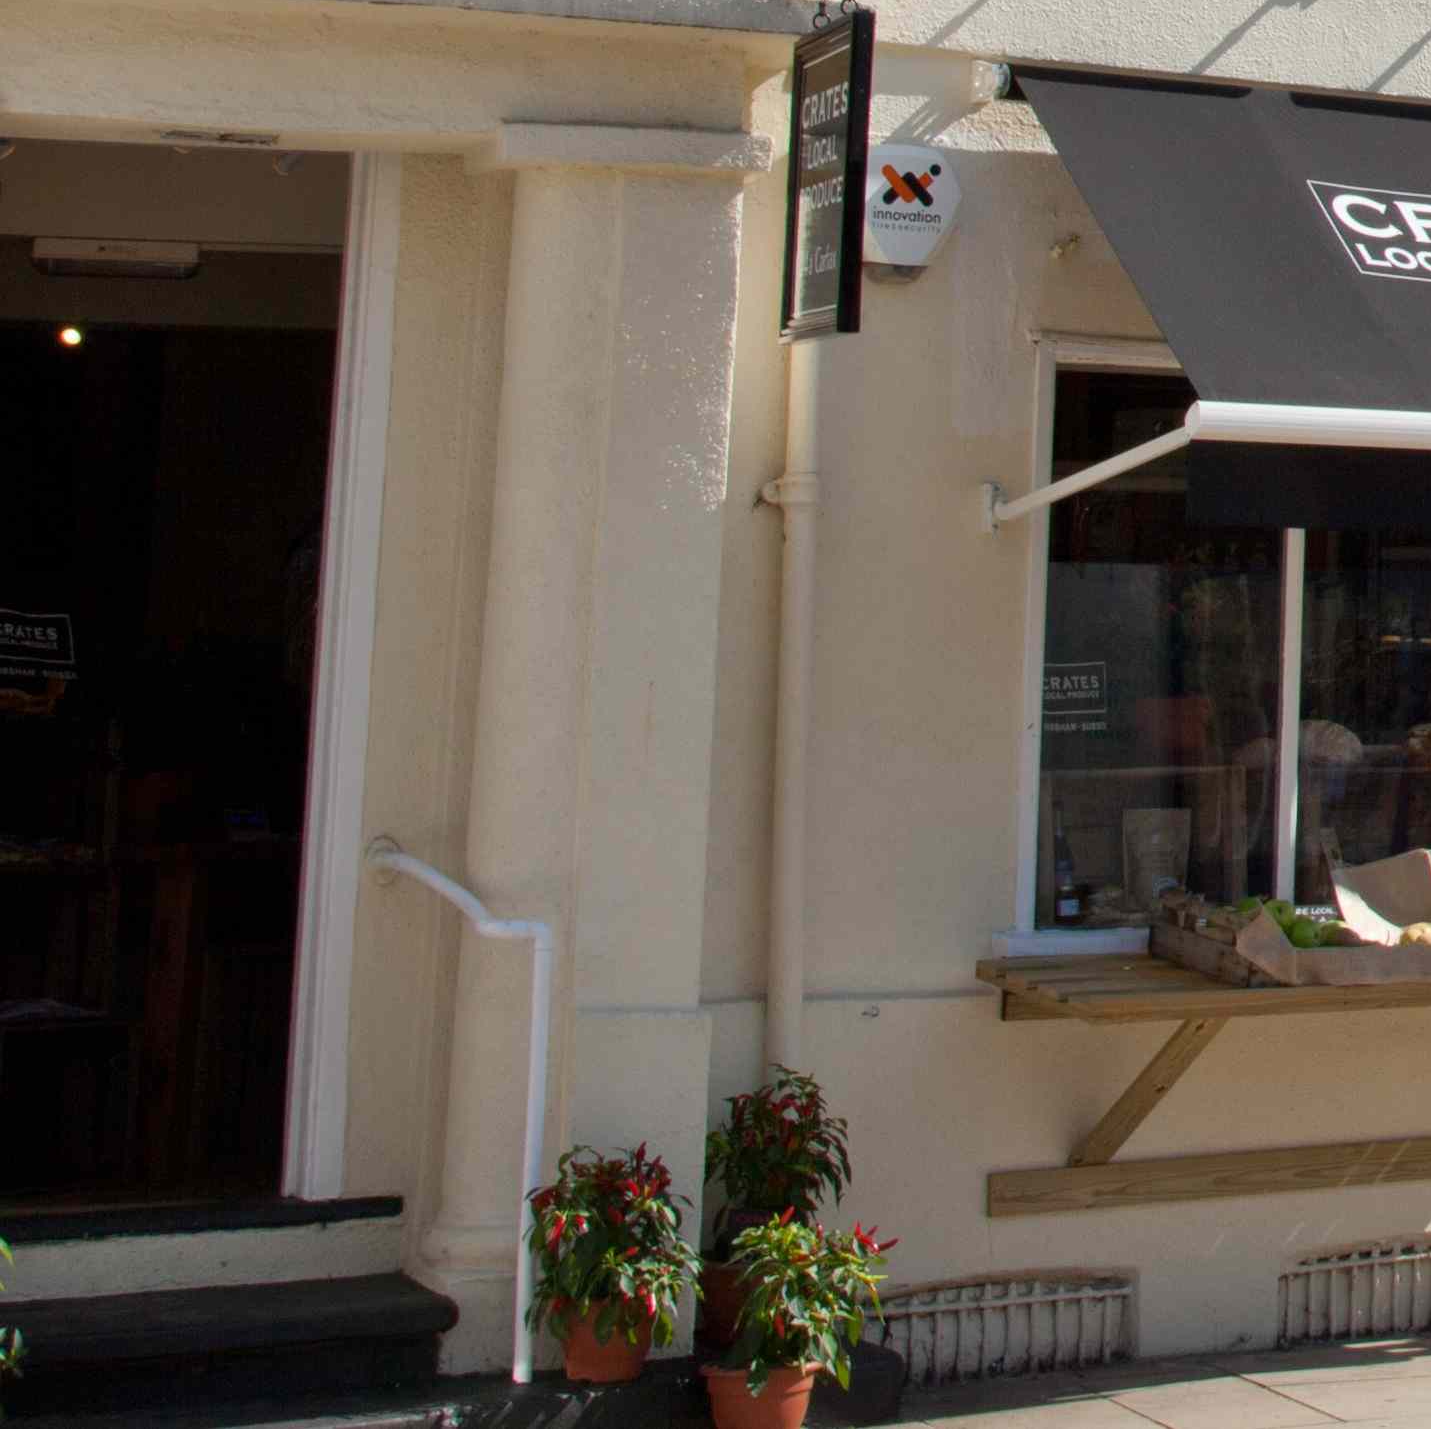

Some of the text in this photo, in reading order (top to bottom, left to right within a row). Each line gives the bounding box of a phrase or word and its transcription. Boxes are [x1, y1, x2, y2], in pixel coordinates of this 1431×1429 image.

[802, 81, 848, 128] CRATES
[807, 134, 838, 170] LOCAL
[873, 206, 941, 224] innovation
[0, 622, 58, 641] RATES
